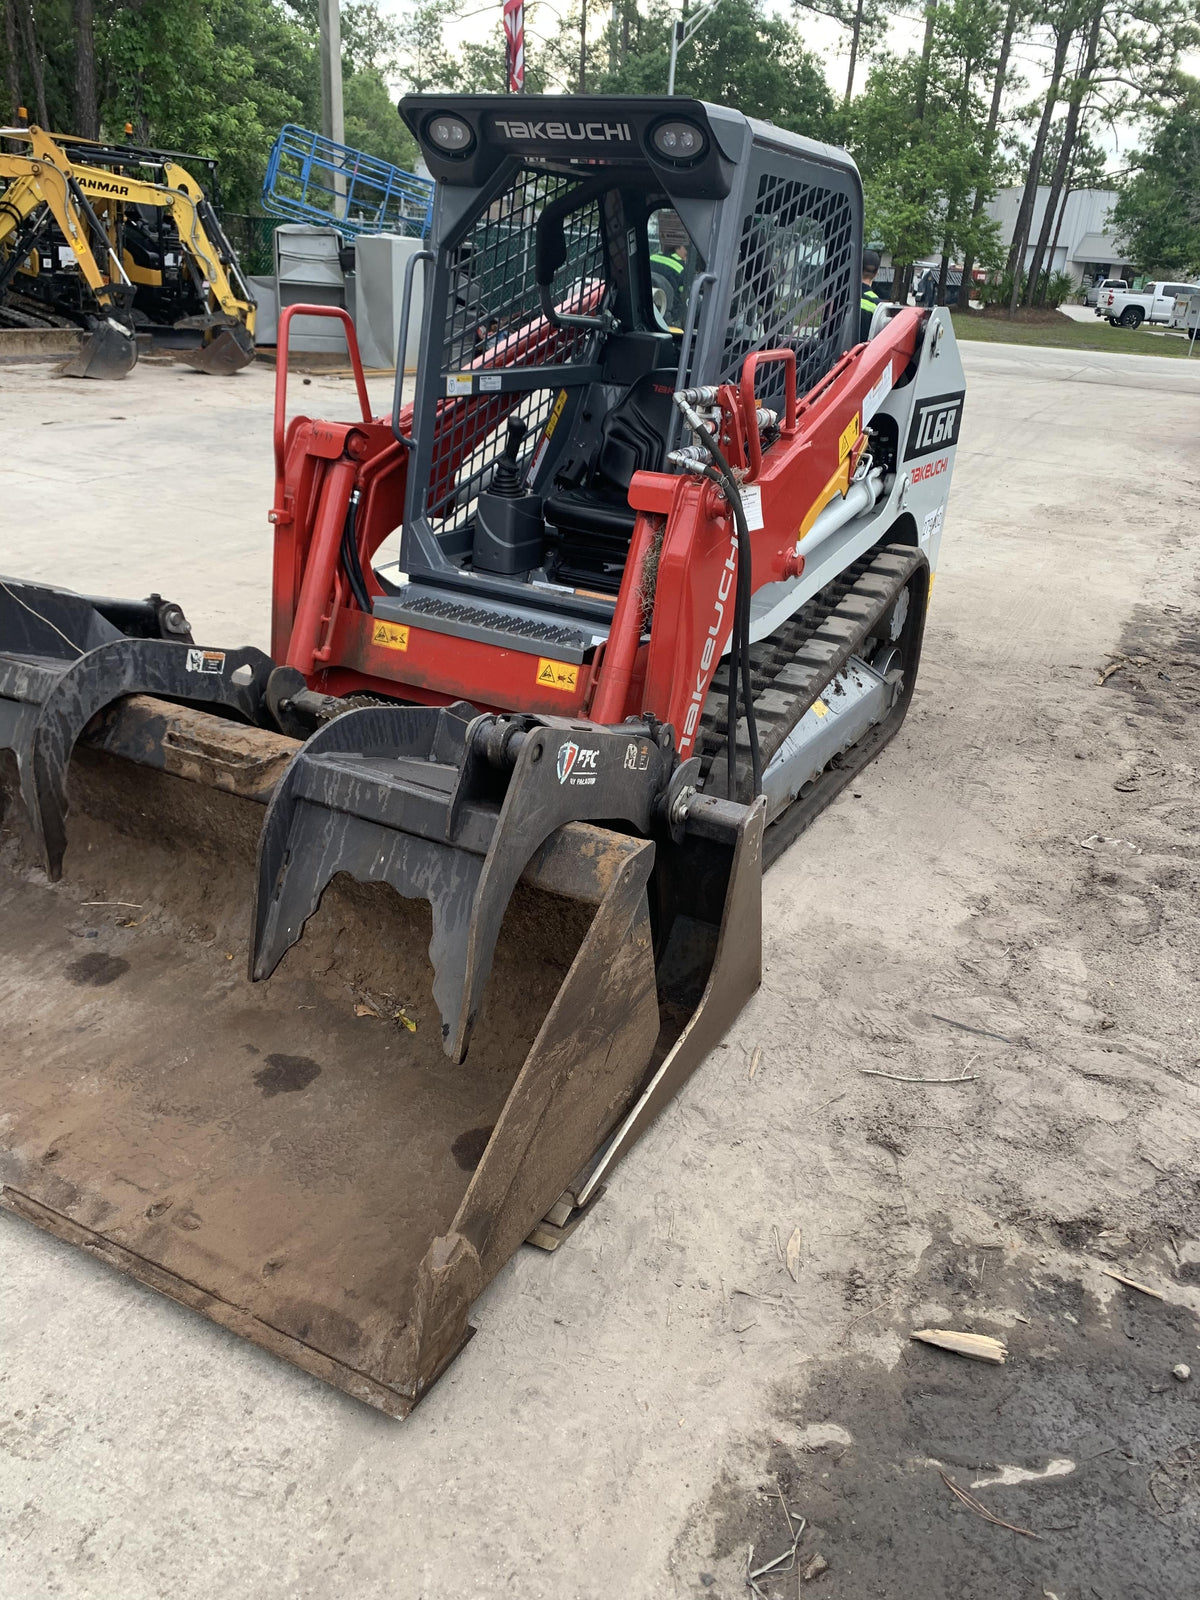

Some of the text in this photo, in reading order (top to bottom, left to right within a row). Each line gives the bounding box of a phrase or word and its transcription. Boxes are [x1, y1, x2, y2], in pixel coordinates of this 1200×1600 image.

[494, 121, 632, 141] TAKEUCHI
[915, 399, 961, 450] TL6R
[910, 457, 949, 485] TAKEUCHI
